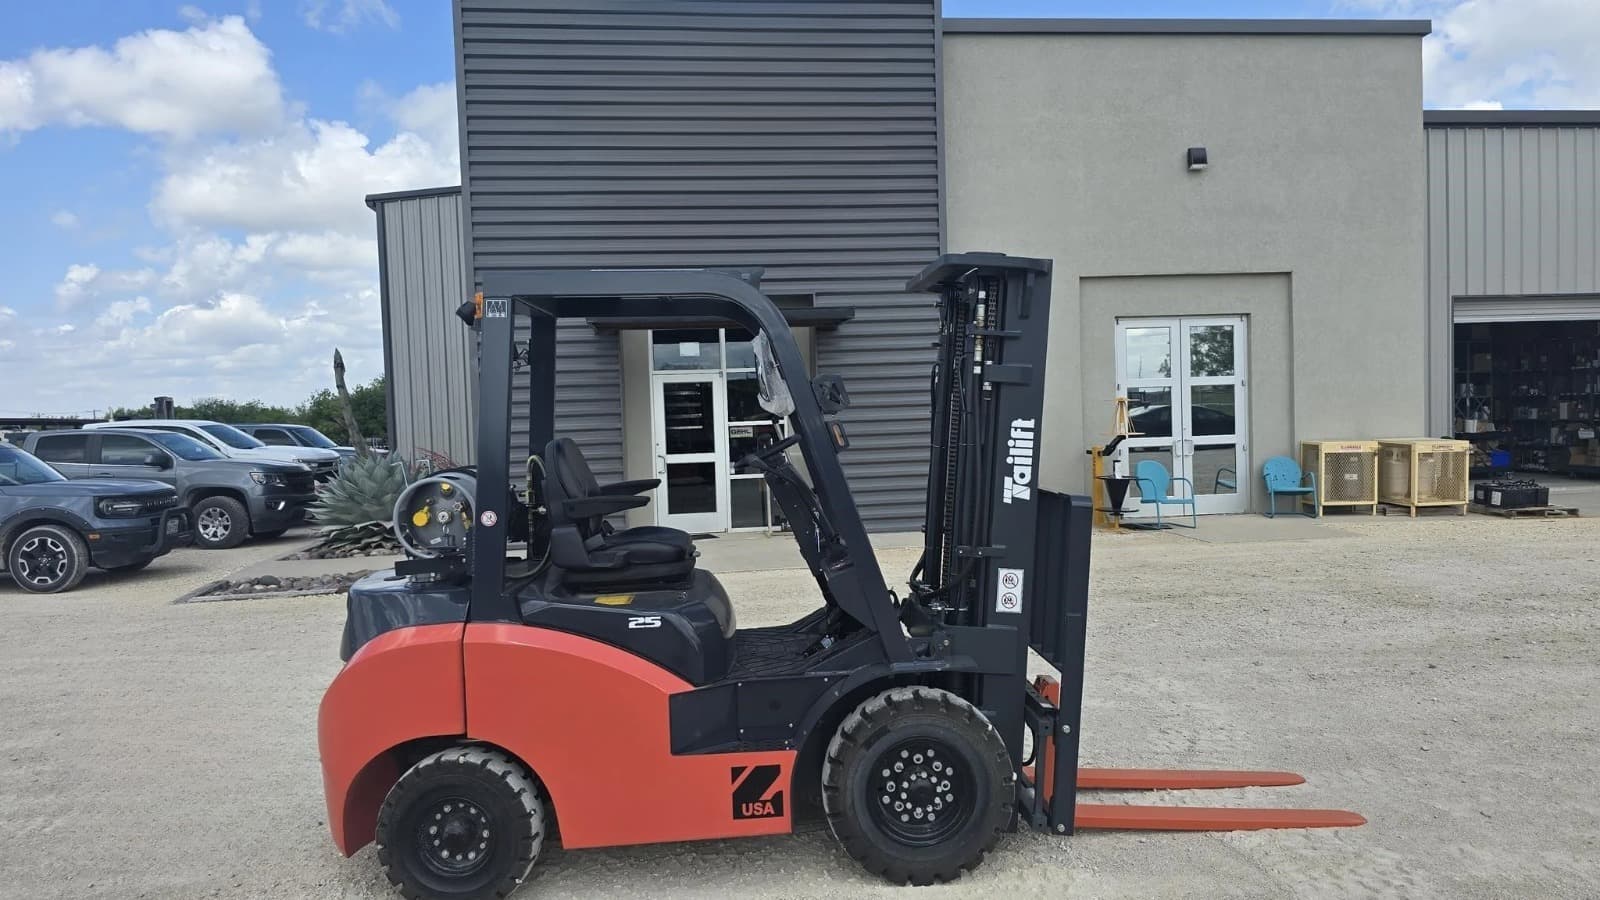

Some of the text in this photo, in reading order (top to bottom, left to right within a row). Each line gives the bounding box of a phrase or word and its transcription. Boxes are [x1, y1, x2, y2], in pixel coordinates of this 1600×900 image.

[1003, 418, 1035, 504] Tailift
[628, 616, 661, 628] 25
[742, 802, 775, 815] USA
